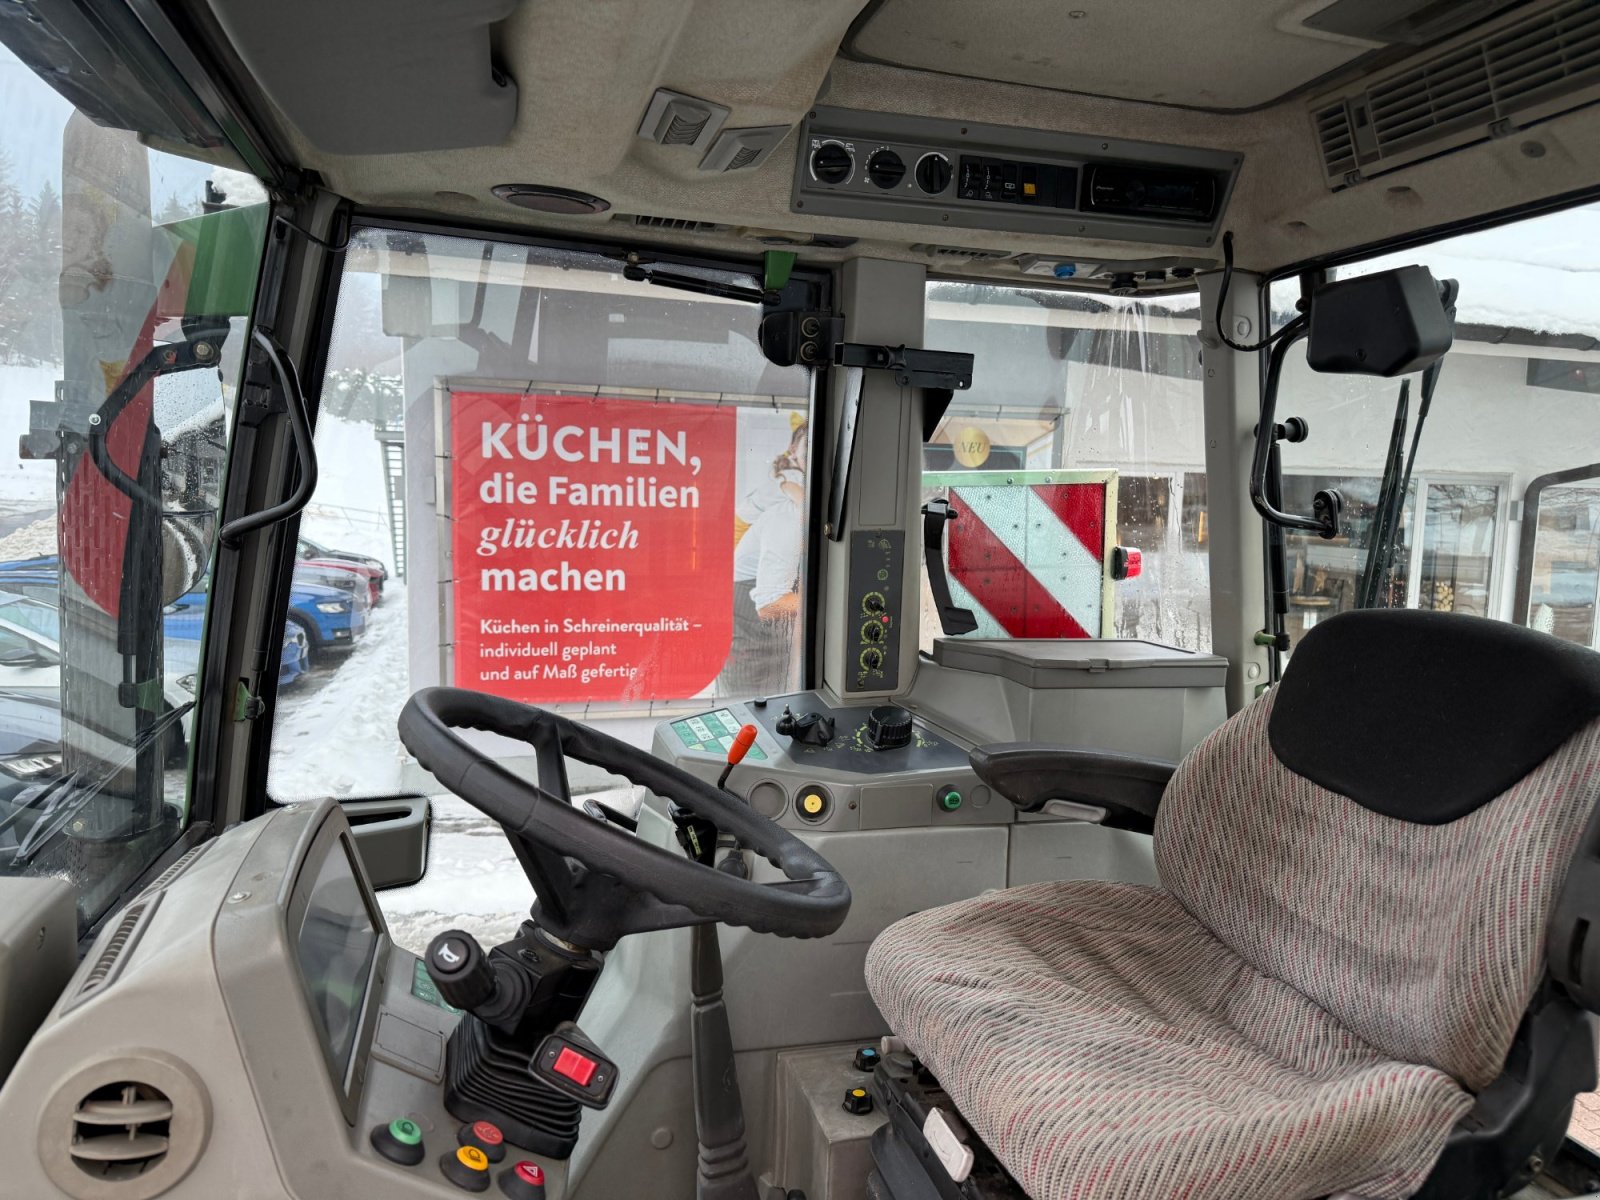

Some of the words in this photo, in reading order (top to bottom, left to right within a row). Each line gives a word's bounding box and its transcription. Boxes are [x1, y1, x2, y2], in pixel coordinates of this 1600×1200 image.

[481, 413, 702, 476] KÜCHEN,
[959, 441, 986, 453] NEU
[479, 472, 538, 505] die
[549, 476, 700, 508] Familien
[476, 518, 639, 556] glücklich
[480, 561, 626, 592] machen
[480, 618, 540, 635] Küchen
[544, 619, 559, 634] in
[563, 617, 689, 637] Schreinerqualität
[480, 641, 558, 658] individuell
[562, 640, 617, 661] geplant
[479, 665, 510, 681] und
[513, 664, 540, 680] auf
[543, 663, 578, 680] Maß
